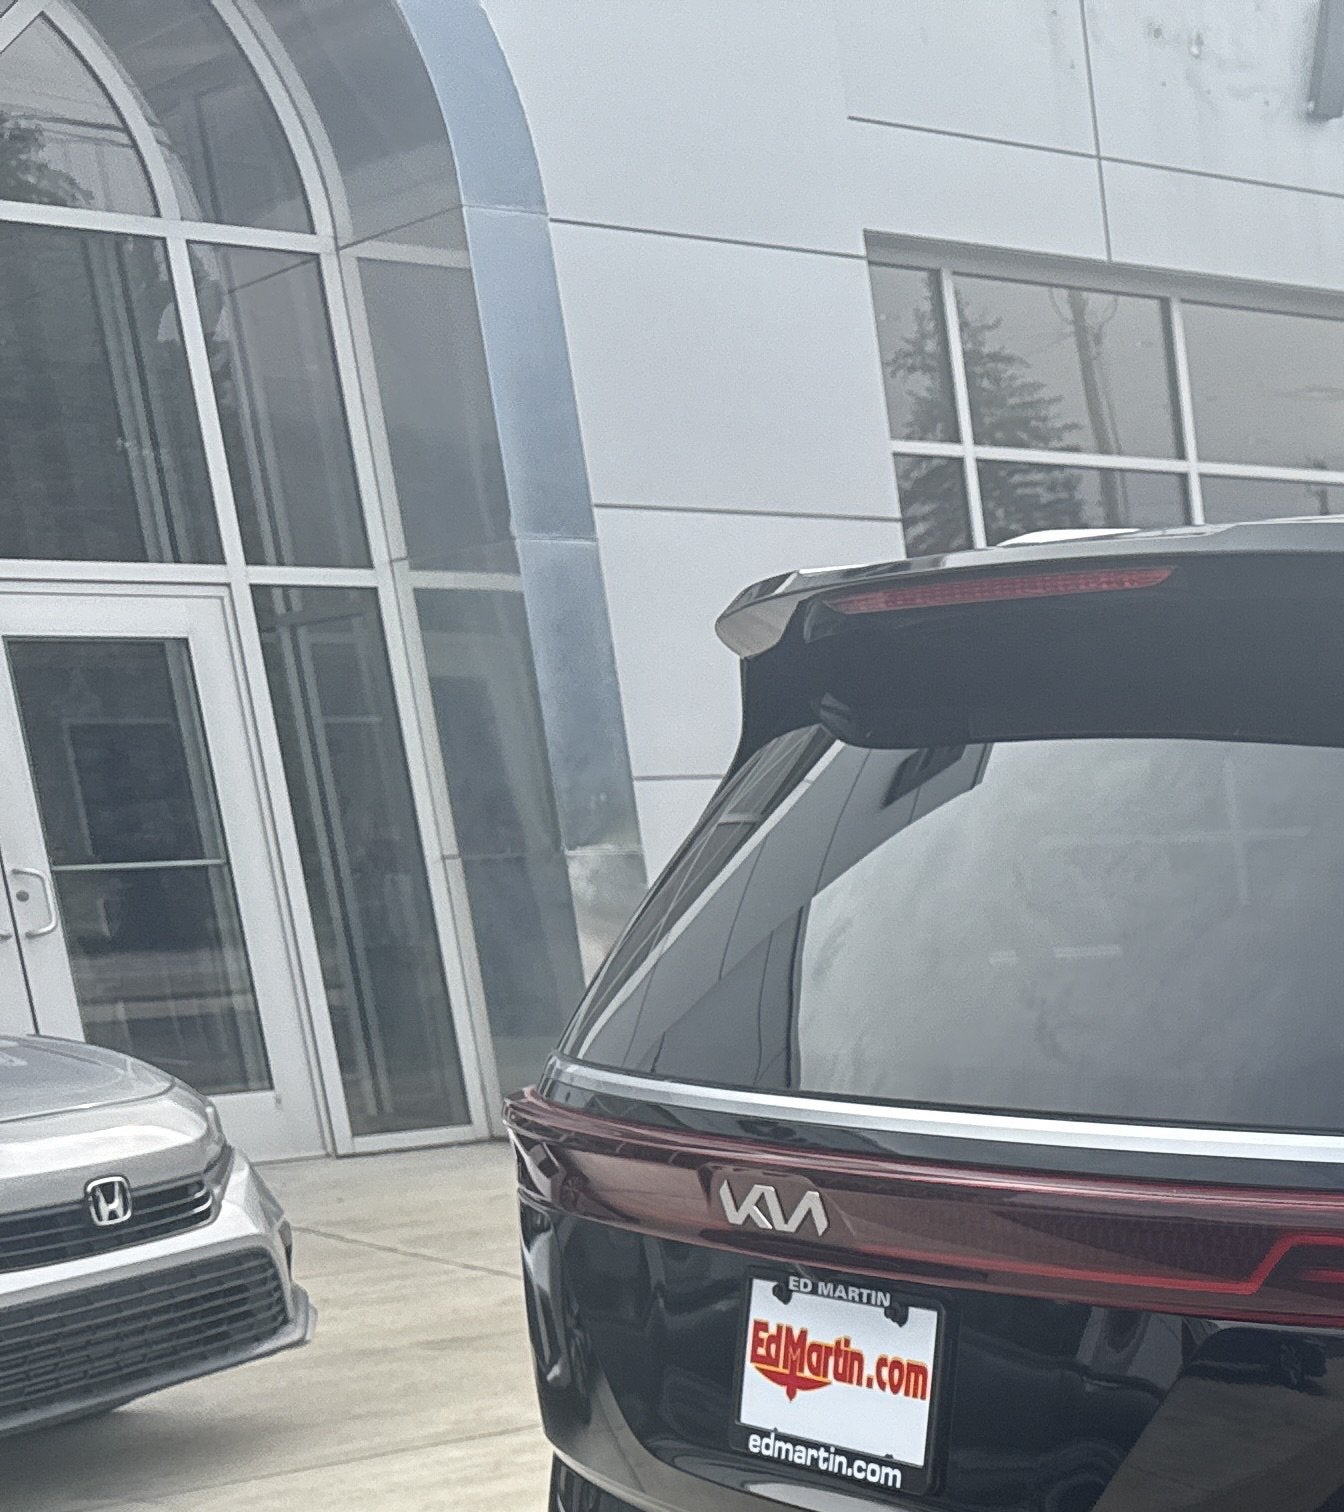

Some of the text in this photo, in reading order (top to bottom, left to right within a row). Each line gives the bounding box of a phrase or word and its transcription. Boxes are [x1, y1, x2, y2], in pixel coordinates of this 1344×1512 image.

[719, 1178, 830, 1237] KIA
[787, 1275, 892, 1307] ED MARTIN
[748, 1432, 902, 1489] edmartin.com
